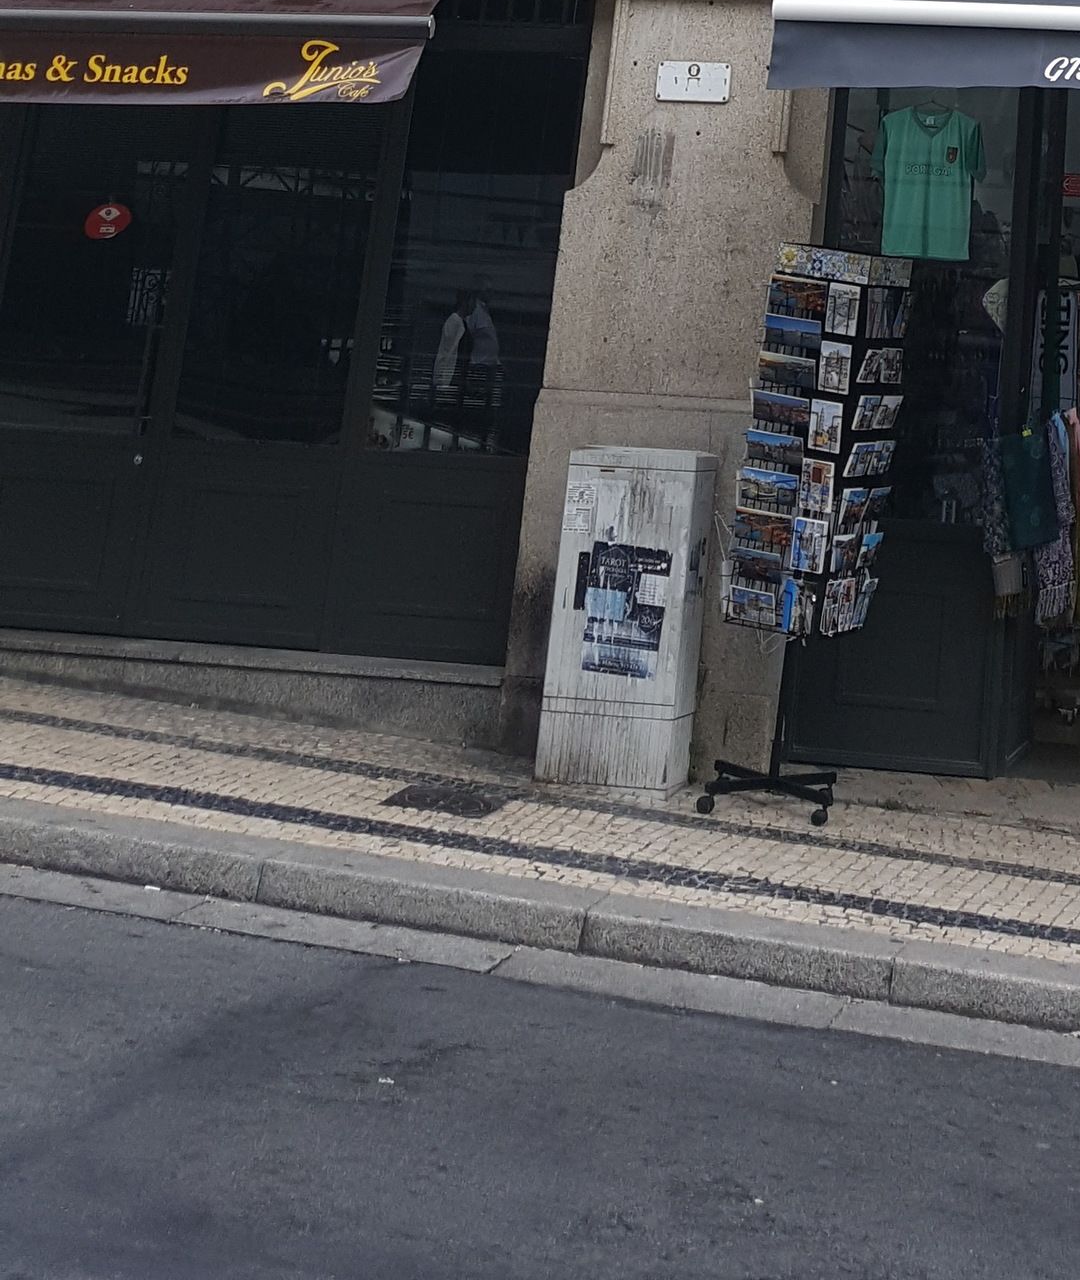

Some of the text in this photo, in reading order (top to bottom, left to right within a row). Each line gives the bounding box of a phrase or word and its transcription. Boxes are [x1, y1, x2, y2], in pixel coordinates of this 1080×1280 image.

[46, 54, 78, 82] &
[83, 53, 190, 85] Snacks
[337, 83, 374, 102] Café
